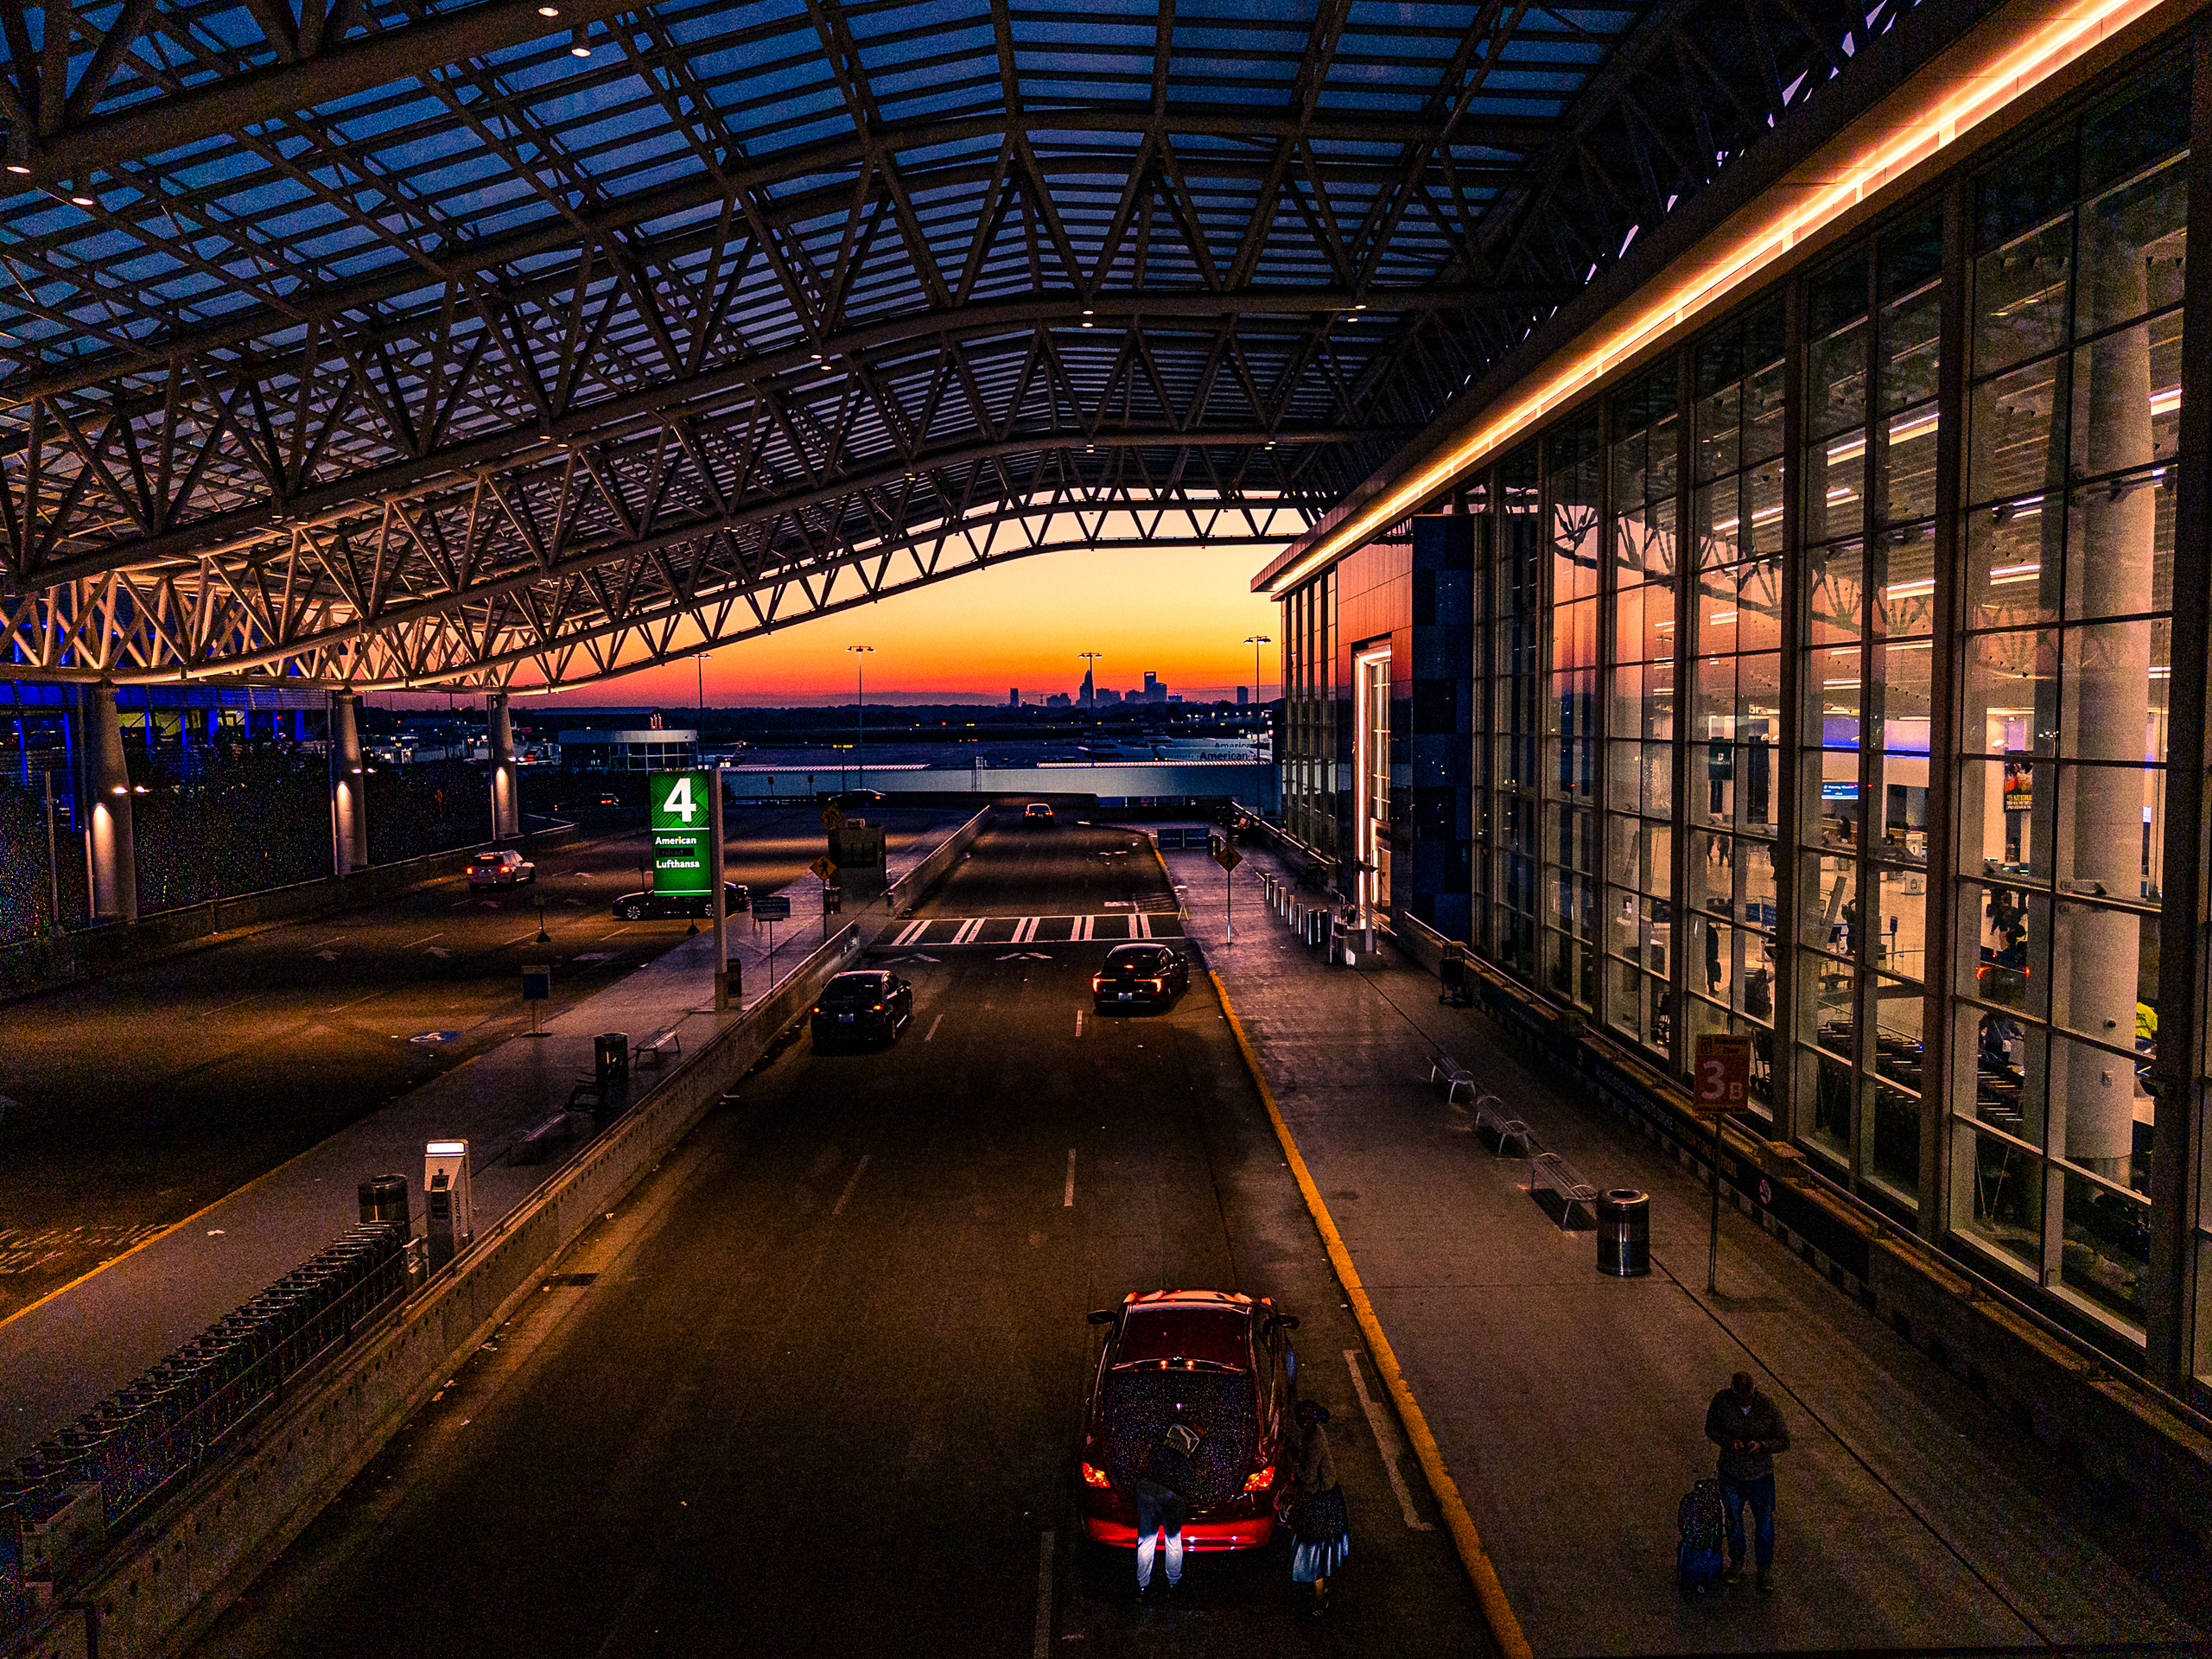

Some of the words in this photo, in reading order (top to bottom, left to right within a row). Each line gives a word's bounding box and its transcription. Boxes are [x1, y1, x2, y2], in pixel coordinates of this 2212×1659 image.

[1199, 751, 1248, 760] American
[663, 777, 696, 823] 4
[655, 836, 697, 845] American
[656, 859, 700, 868] Lufthansa
